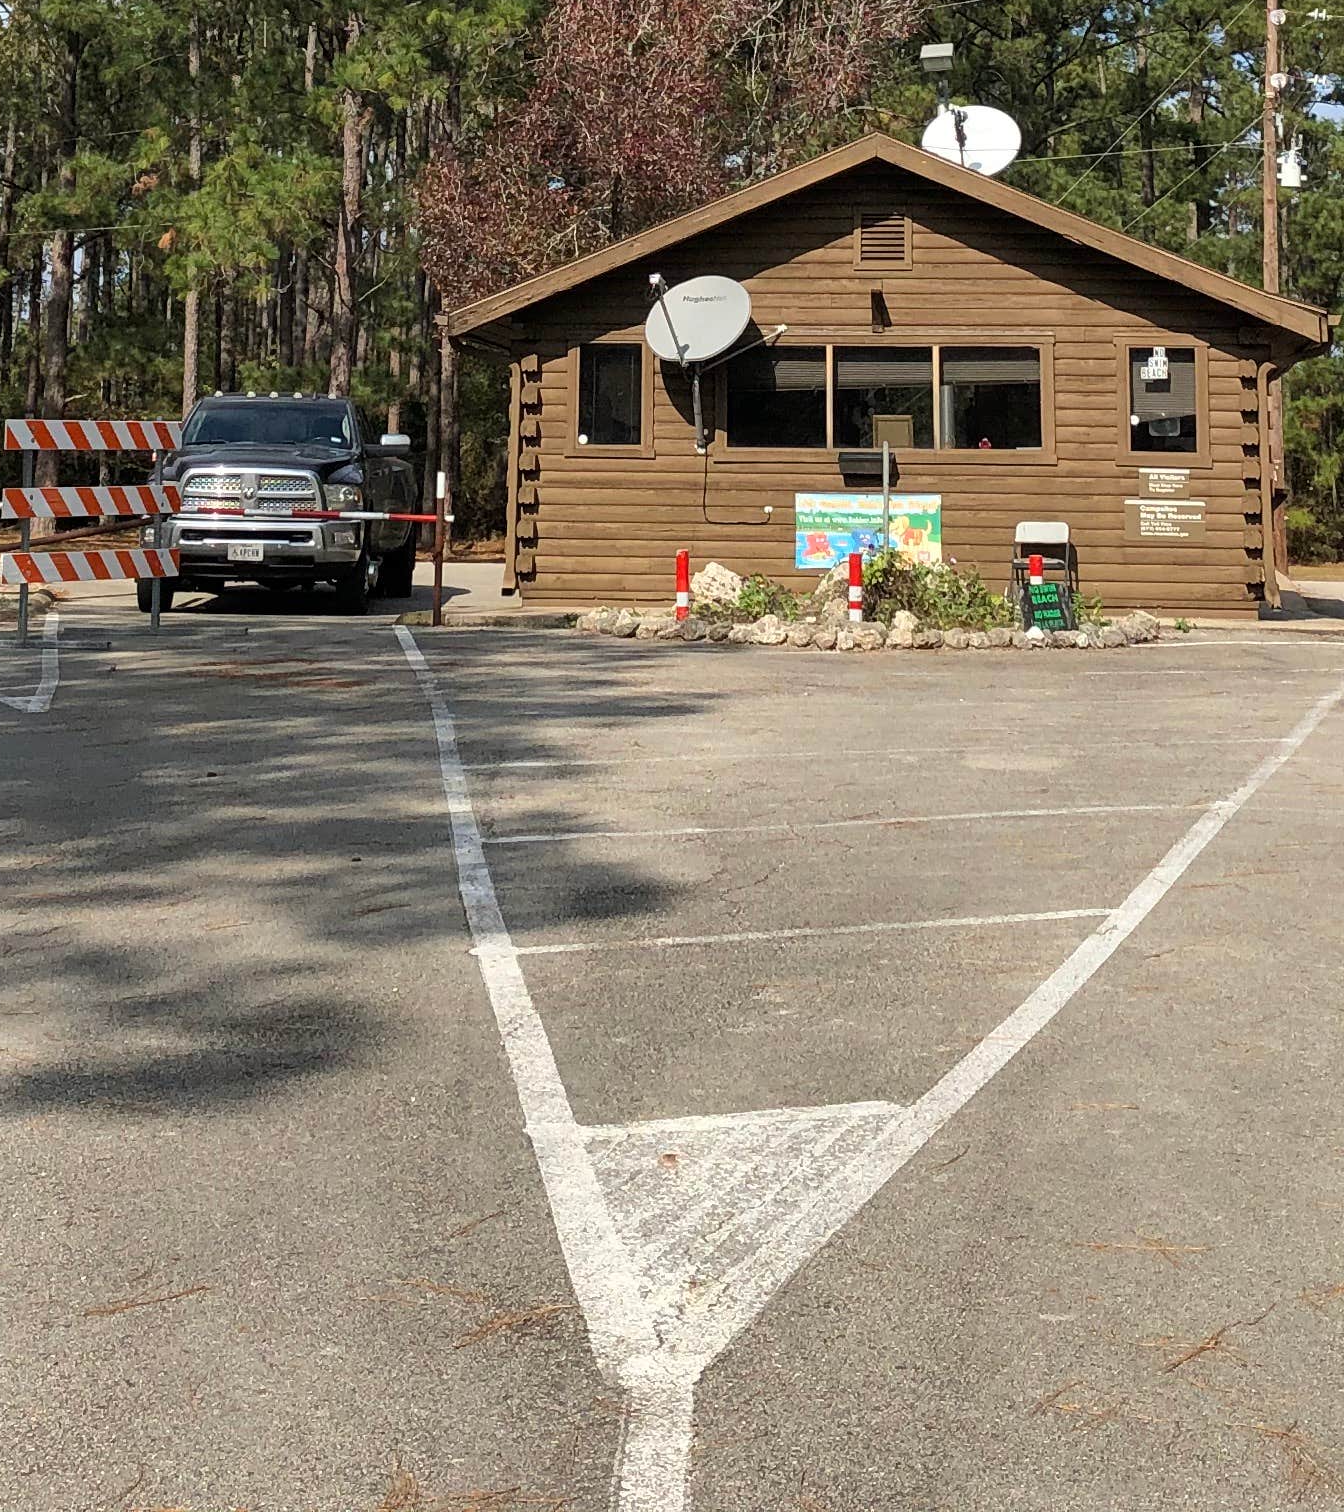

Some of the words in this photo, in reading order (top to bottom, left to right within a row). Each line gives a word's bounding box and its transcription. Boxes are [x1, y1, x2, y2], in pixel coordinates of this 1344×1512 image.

[1153, 348, 1165, 357] NO
[1149, 358, 1168, 367] SWIM
[1141, 367, 1168, 378] BEACH
